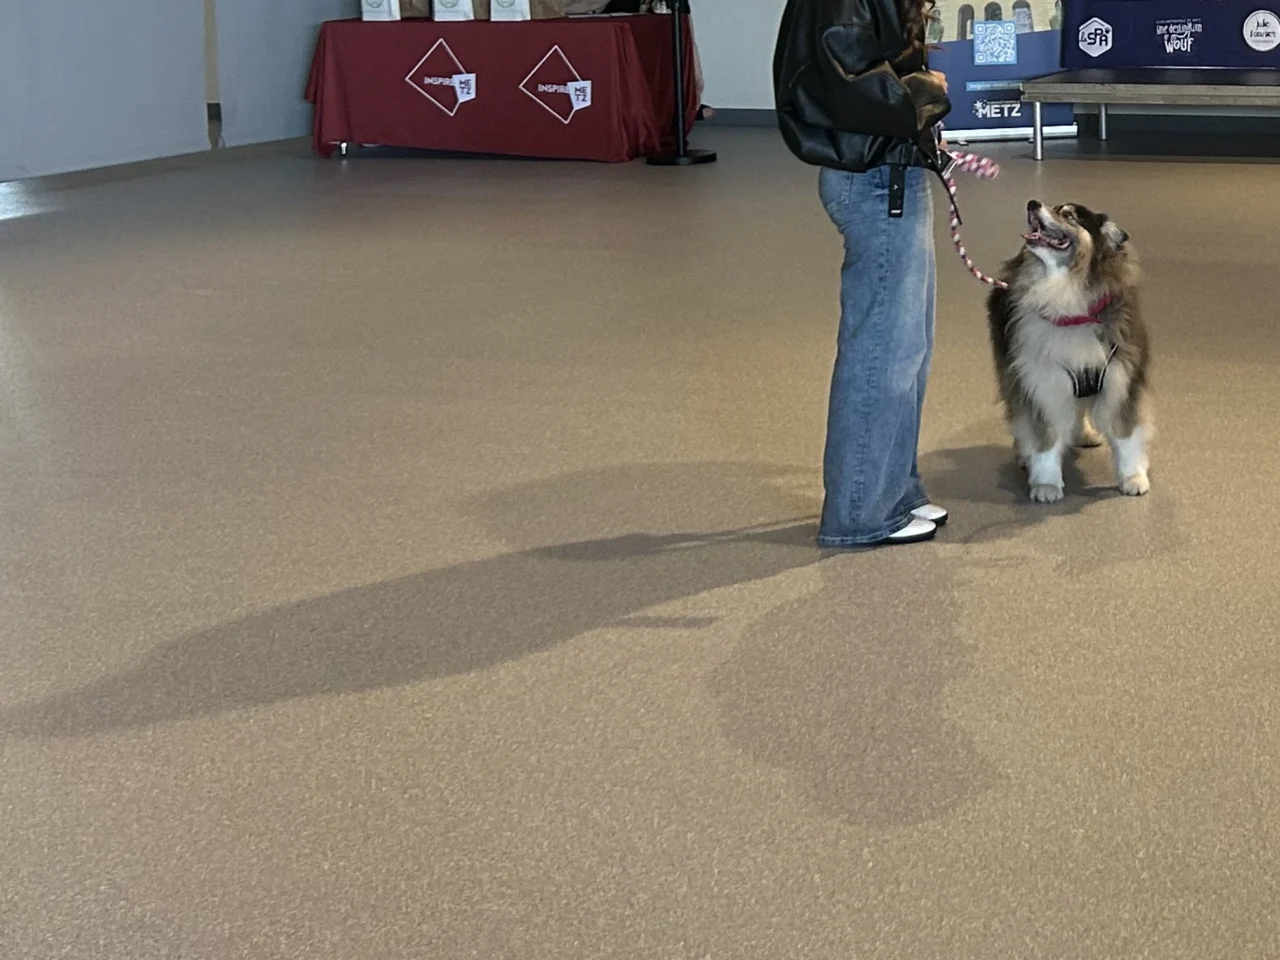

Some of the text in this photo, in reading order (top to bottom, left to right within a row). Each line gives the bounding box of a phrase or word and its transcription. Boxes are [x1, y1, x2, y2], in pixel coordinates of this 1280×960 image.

[1087, 28, 1108, 46] SPA
[424, 77, 455, 87] INSPIRE
[538, 84, 569, 94] INSPIRE
[978, 104, 1022, 118] METZ
